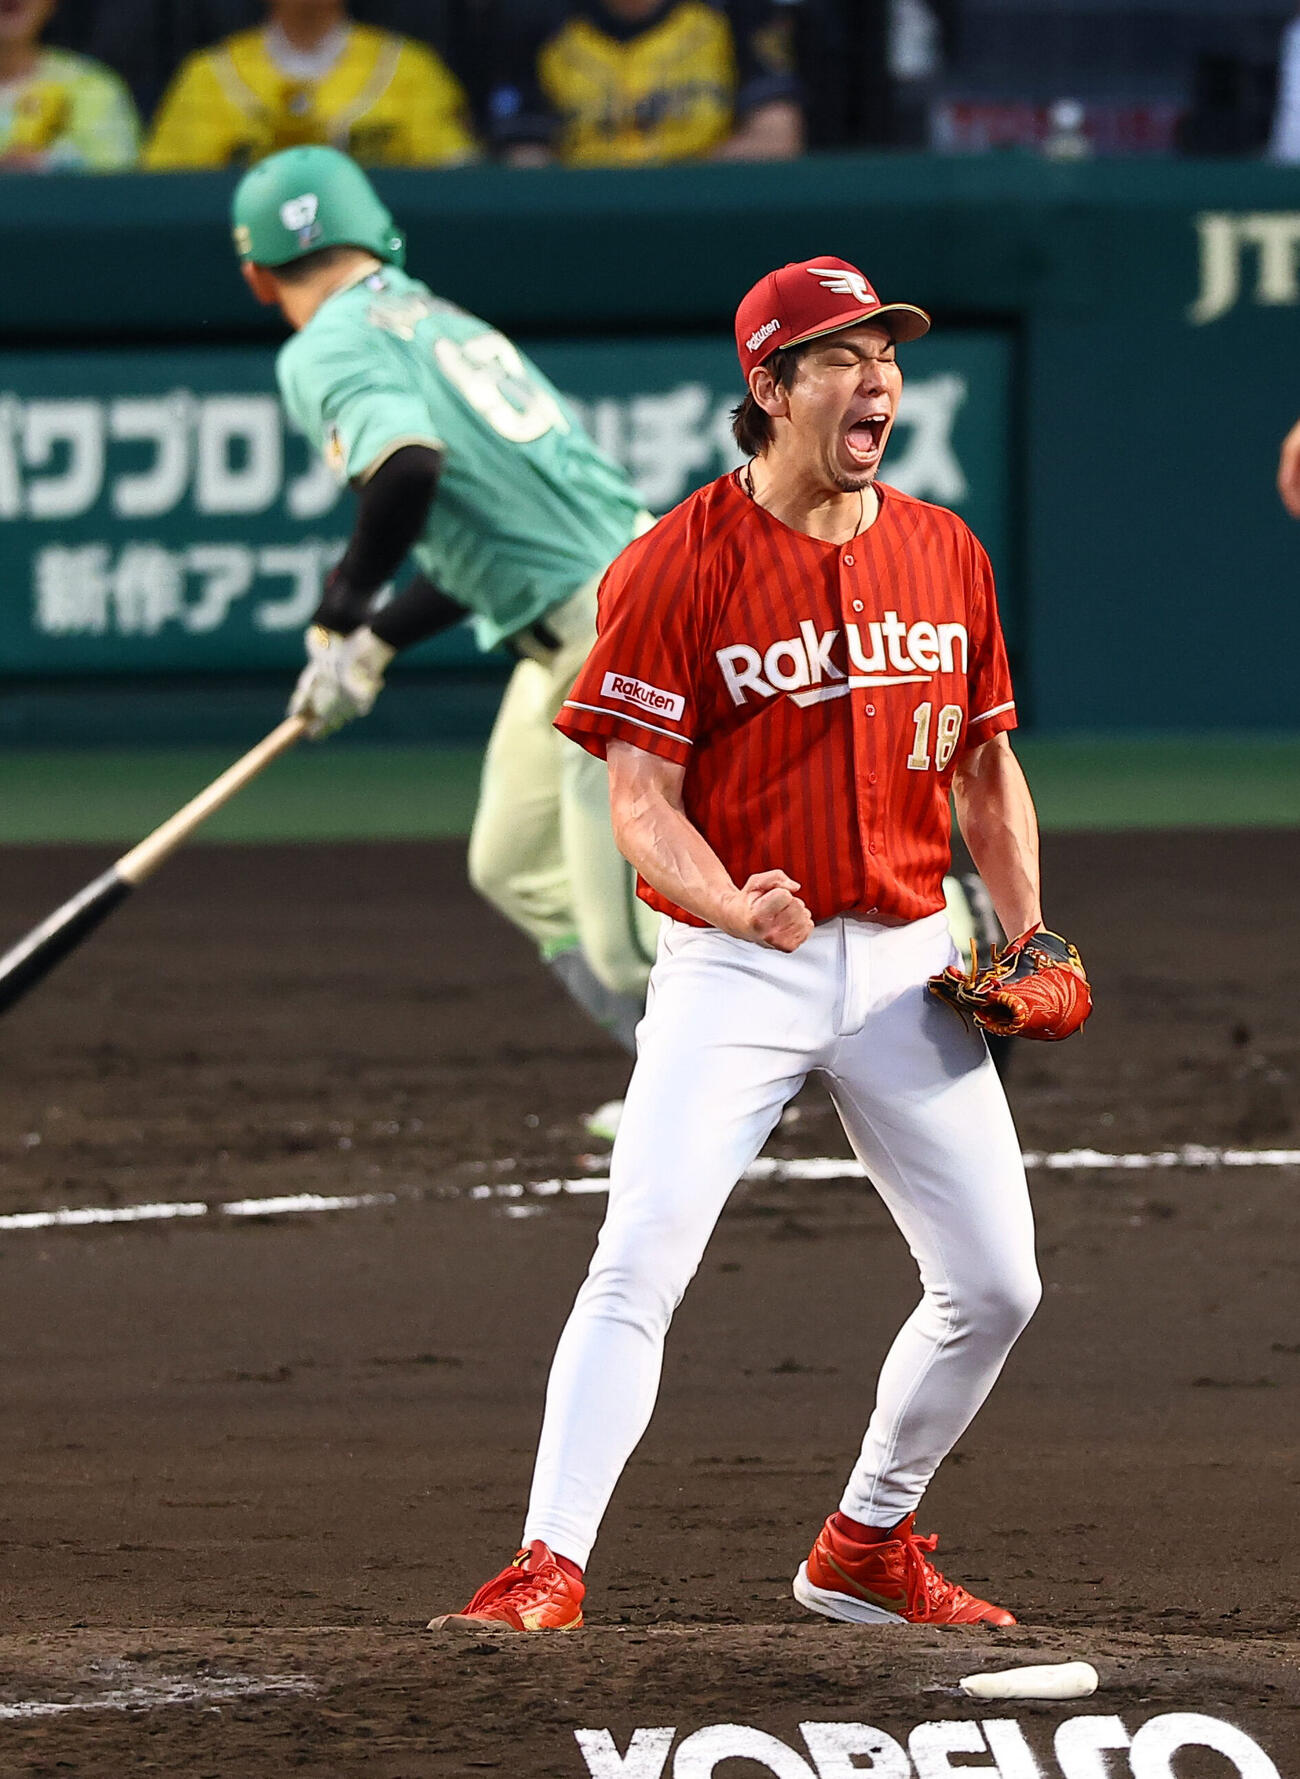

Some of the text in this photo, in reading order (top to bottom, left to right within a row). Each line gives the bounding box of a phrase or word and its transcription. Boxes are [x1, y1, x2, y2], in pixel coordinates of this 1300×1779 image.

[745, 318, 781, 353] Rakuten
[715, 610, 968, 708] Rakuten
[611, 676, 675, 712] Rakuten
[907, 701, 963, 772] 18
